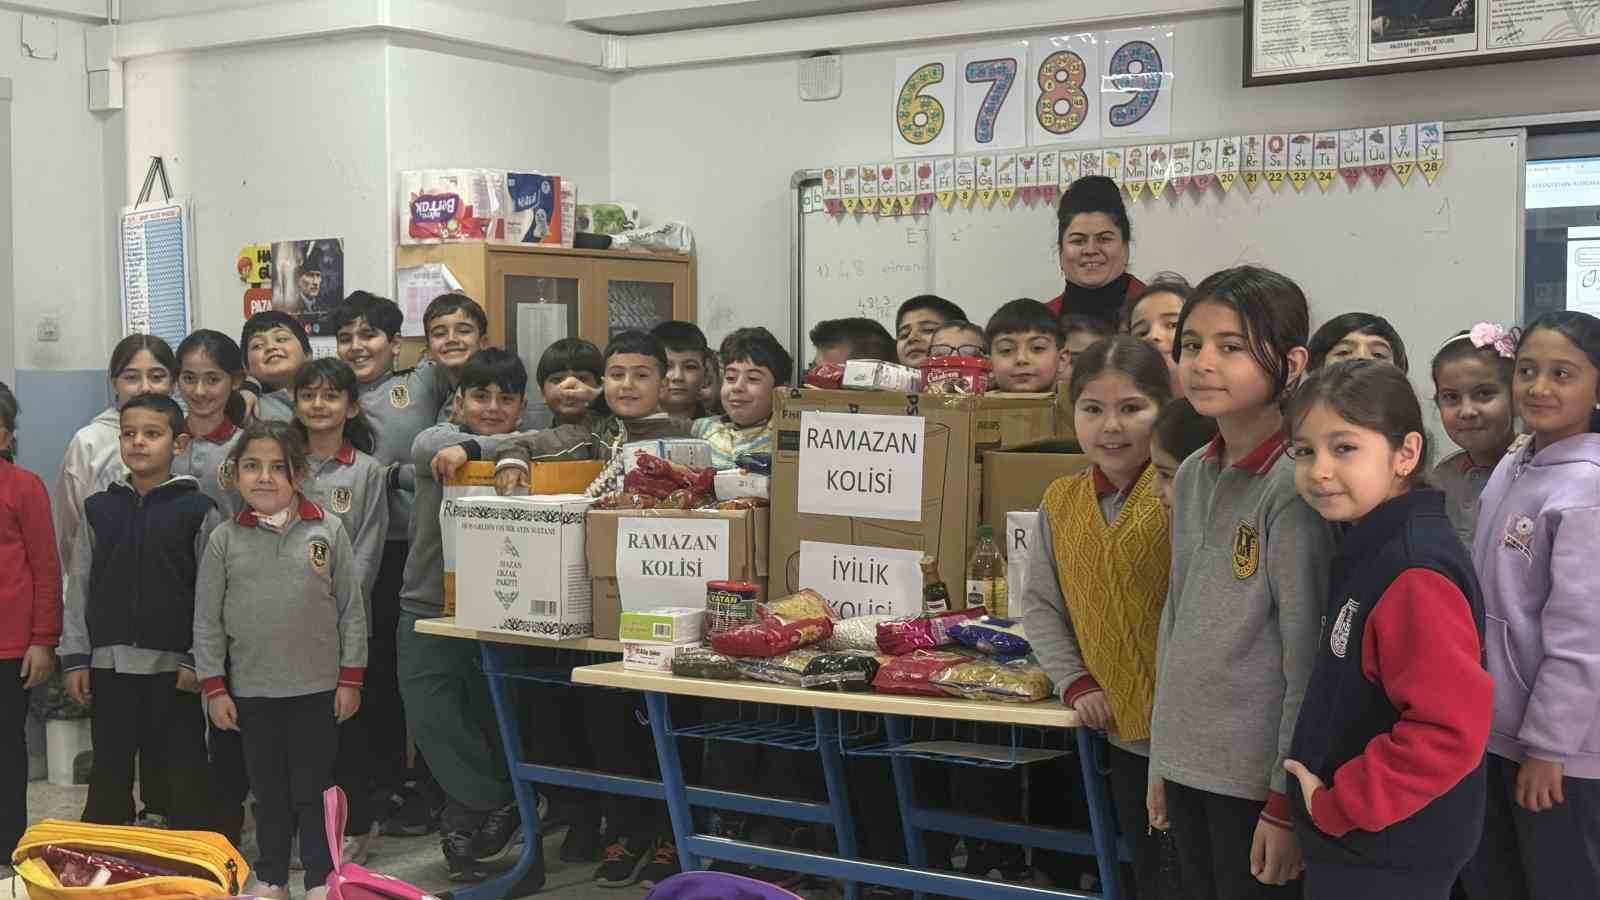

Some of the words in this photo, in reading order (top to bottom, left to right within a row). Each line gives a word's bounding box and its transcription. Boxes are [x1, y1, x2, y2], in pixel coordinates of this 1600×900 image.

[896, 62, 944, 145] 6
[966, 57, 1017, 143] 7
[1036, 50, 1088, 134] 8
[1109, 41, 1162, 127] 9
[807, 428, 917, 454] RAMAZAN
[827, 466, 896, 494] KOLİSİ
[628, 533, 718, 551] RAMAZAN
[641, 557, 704, 577] KOLİSİ
[833, 555, 889, 585] İYİLİK
[711, 595, 737, 603] VATAN
